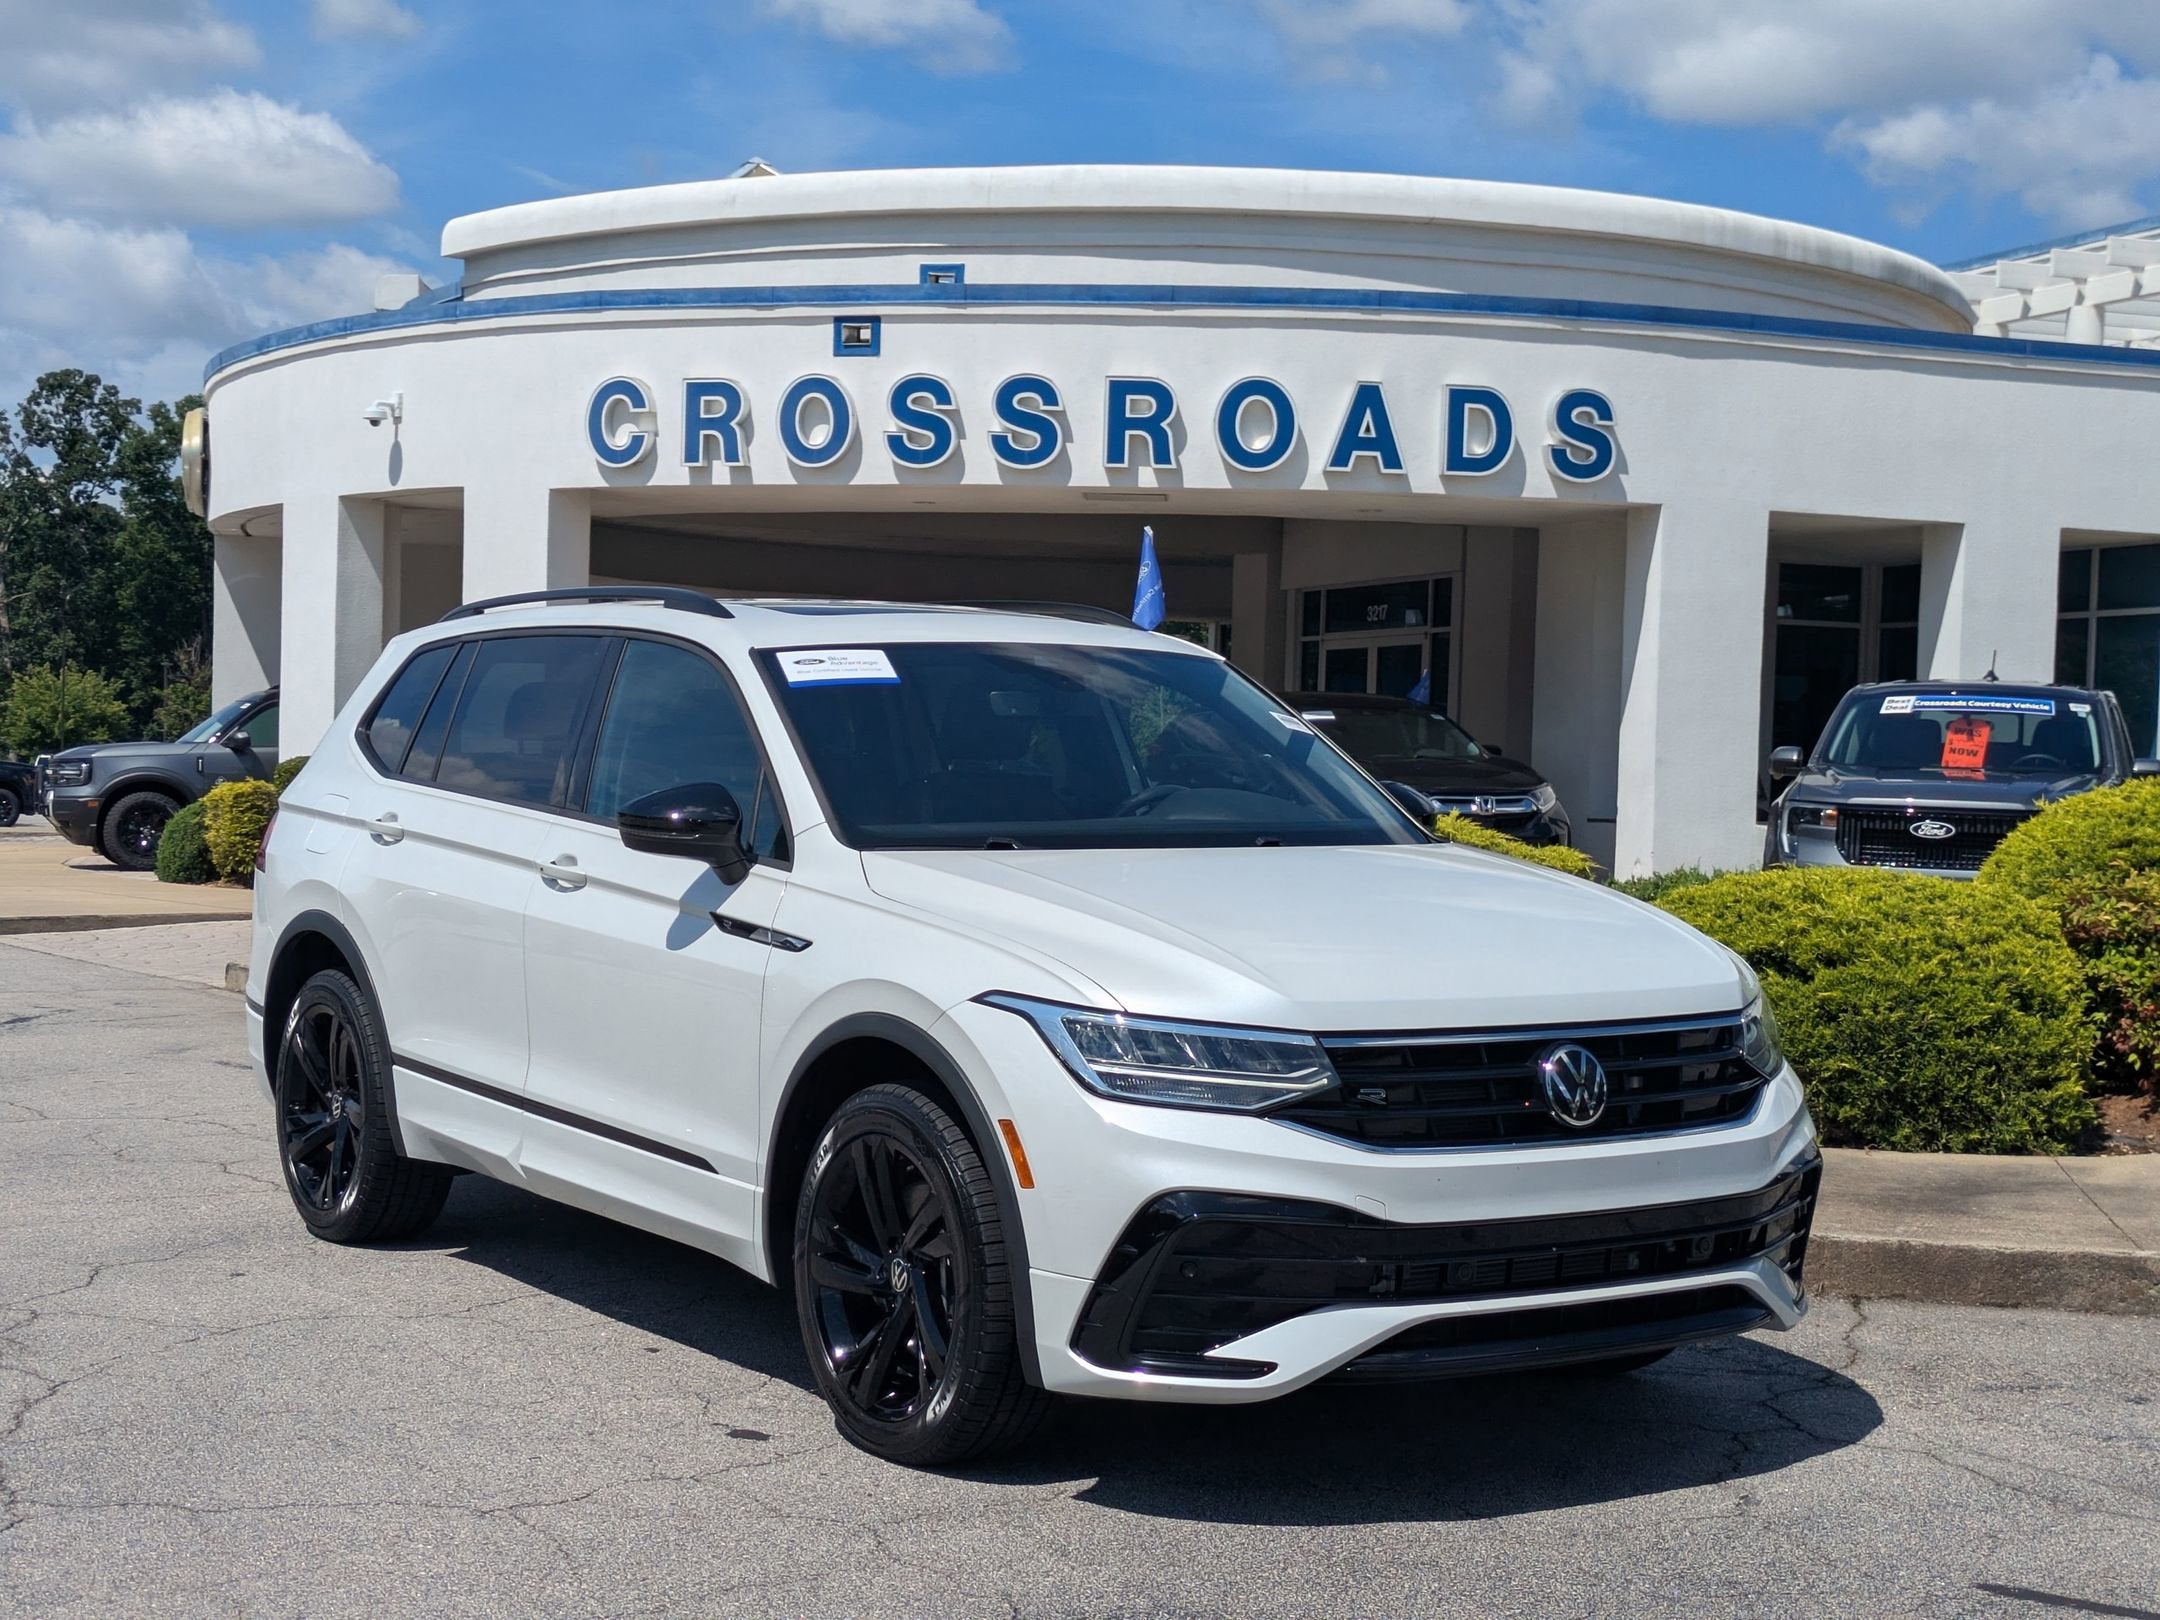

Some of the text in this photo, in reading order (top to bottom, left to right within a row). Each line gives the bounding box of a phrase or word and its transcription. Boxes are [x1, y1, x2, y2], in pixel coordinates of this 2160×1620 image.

[587, 373, 1616, 483] CROSSROADS
[1366, 605, 1388, 621] 3217
[1968, 700, 2011, 709] Courtesy
[2012, 702, 2050, 711] Vehicle
[1948, 747, 1979, 757] NOW
[1918, 822, 1947, 835] Ford
